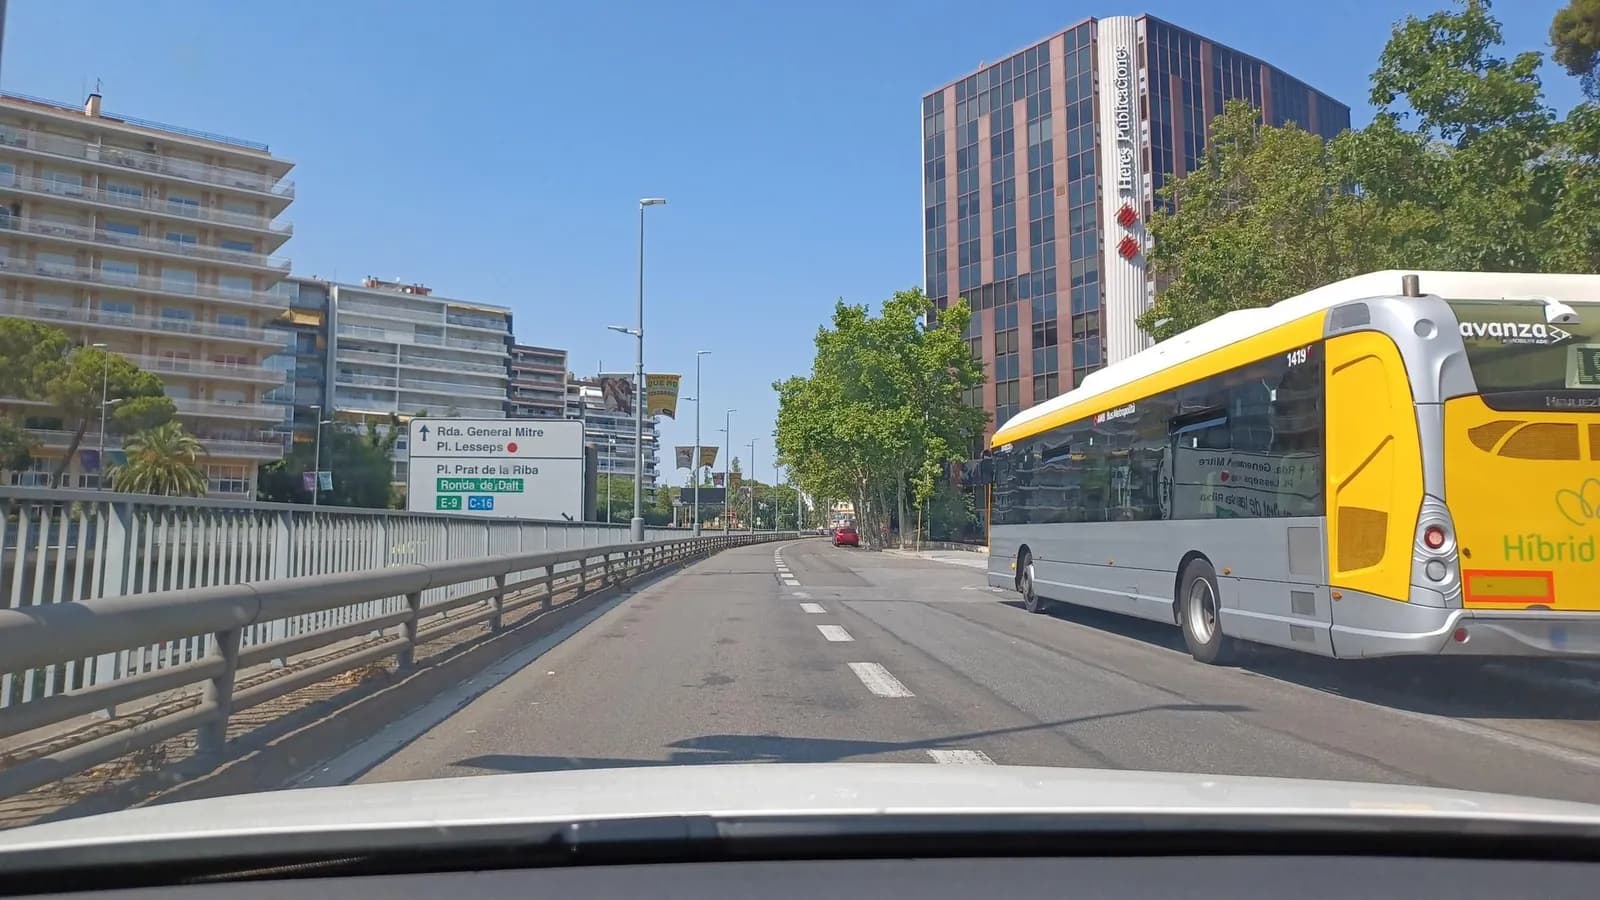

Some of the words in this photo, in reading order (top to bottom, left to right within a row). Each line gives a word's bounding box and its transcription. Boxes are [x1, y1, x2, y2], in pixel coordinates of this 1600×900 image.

[1114, 45, 1130, 141] Publicaciones
[1118, 148, 1133, 190] Heres
[1459, 321, 1547, 338] avanza
[1287, 348, 1307, 368] 1419
[437, 426, 463, 437] Rda.
[467, 426, 512, 437] General
[515, 426, 544, 437] Mitre
[437, 441, 451, 452] Pl.
[455, 441, 503, 453] Lesseps
[436, 464, 451, 474] Pl.
[455, 464, 478, 474] Prat
[481, 464, 496, 475] de
[500, 464, 509, 475] la
[513, 465, 539, 475] Riba
[441, 480, 475, 490] Ronda
[480, 479, 493, 490] de
[499, 480, 519, 490] Dalt
[441, 498, 457, 508] E-9
[470, 498, 492, 508] C-16
[1503, 533, 1596, 563] Híbrid
